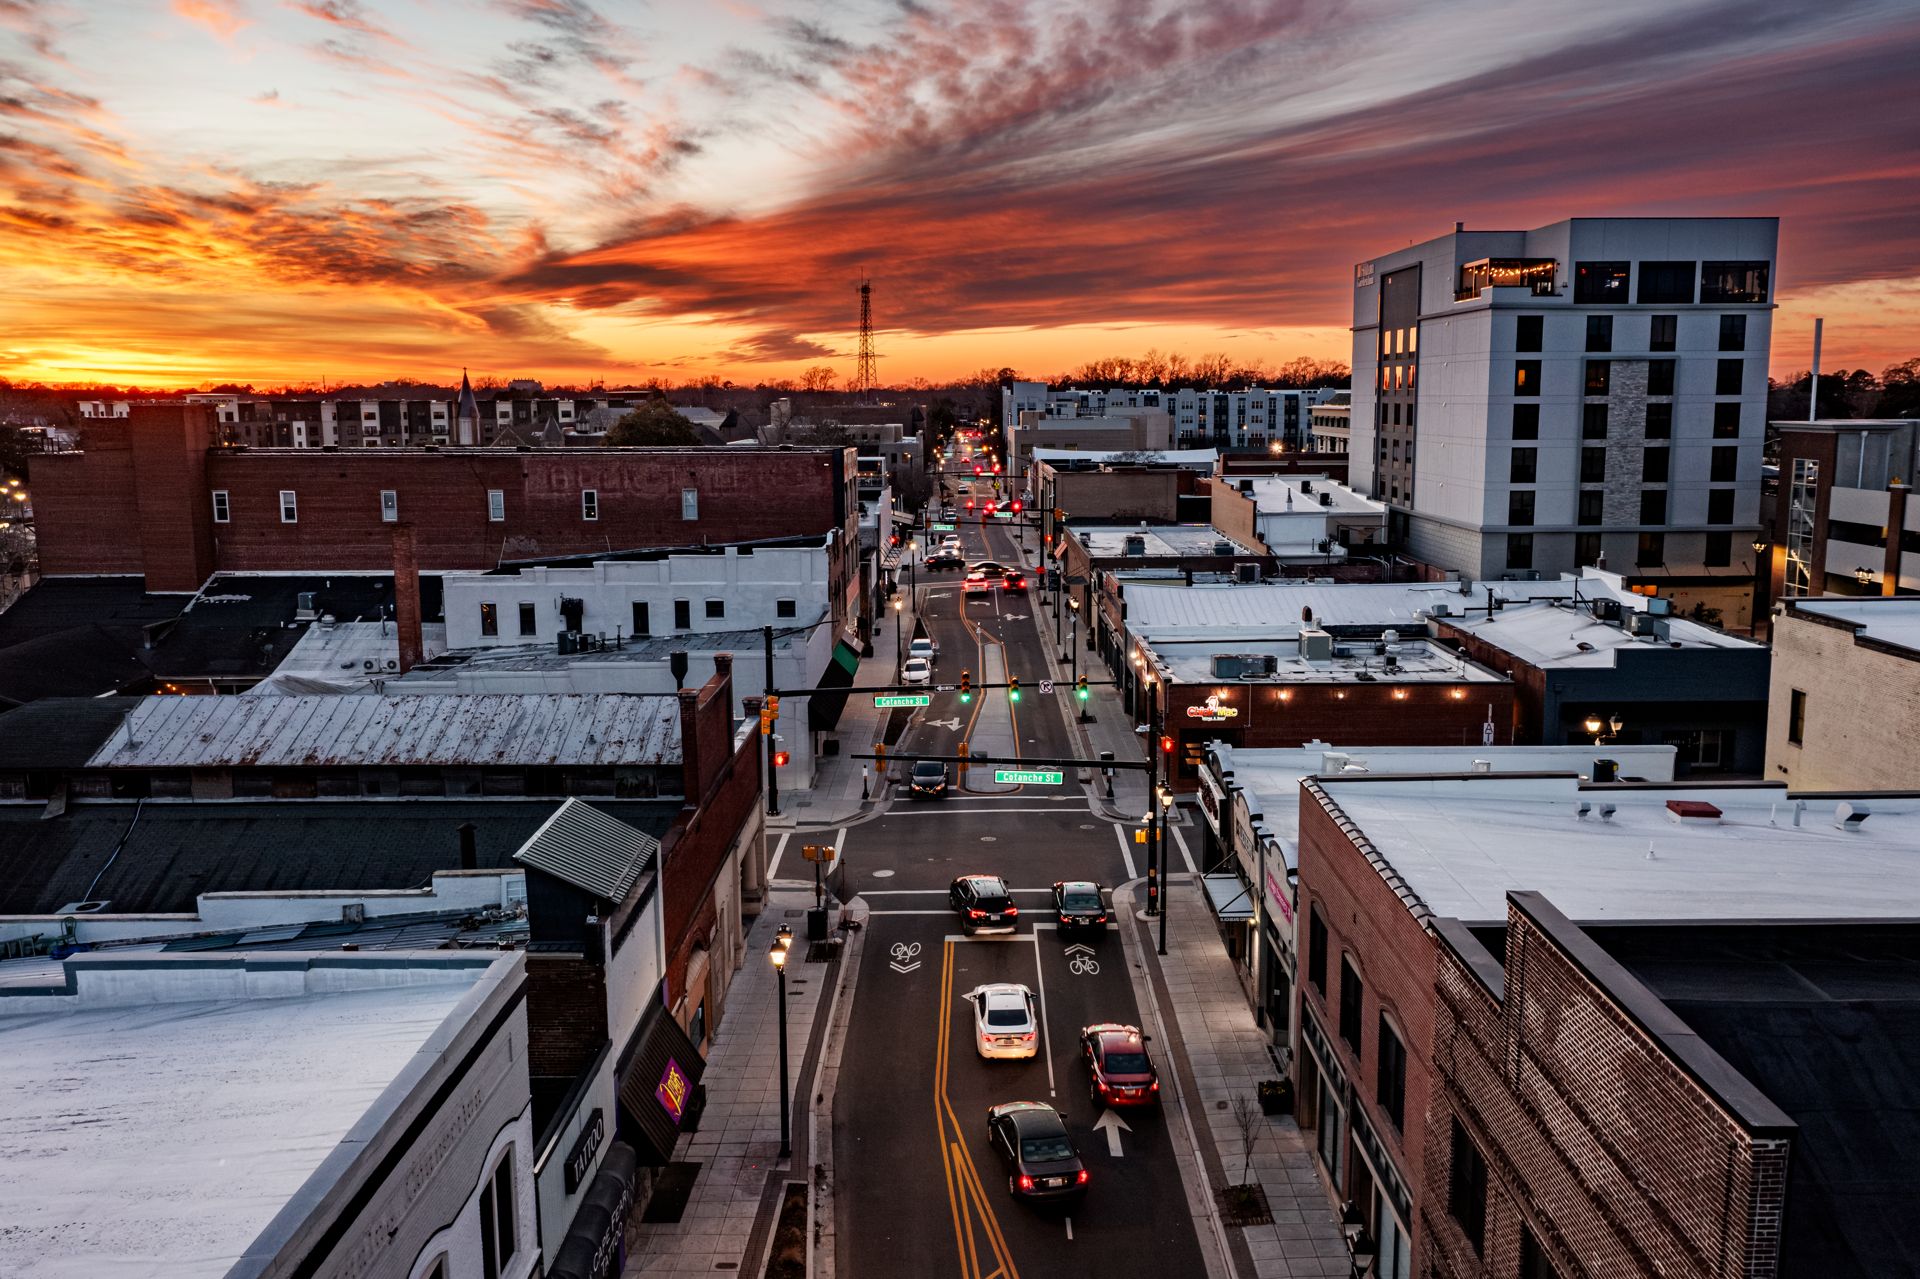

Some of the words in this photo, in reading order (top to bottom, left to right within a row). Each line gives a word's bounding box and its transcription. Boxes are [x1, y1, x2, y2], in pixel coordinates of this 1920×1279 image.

[881, 697, 914, 706] Cotanche
[915, 696, 924, 705] St
[1002, 773, 1043, 783] Cotanche
[1045, 774, 1056, 783] St
[574, 1118, 603, 1183] TATTOO
[592, 1226, 611, 1272] CAPE
[601, 1221, 624, 1277] TATTOO
